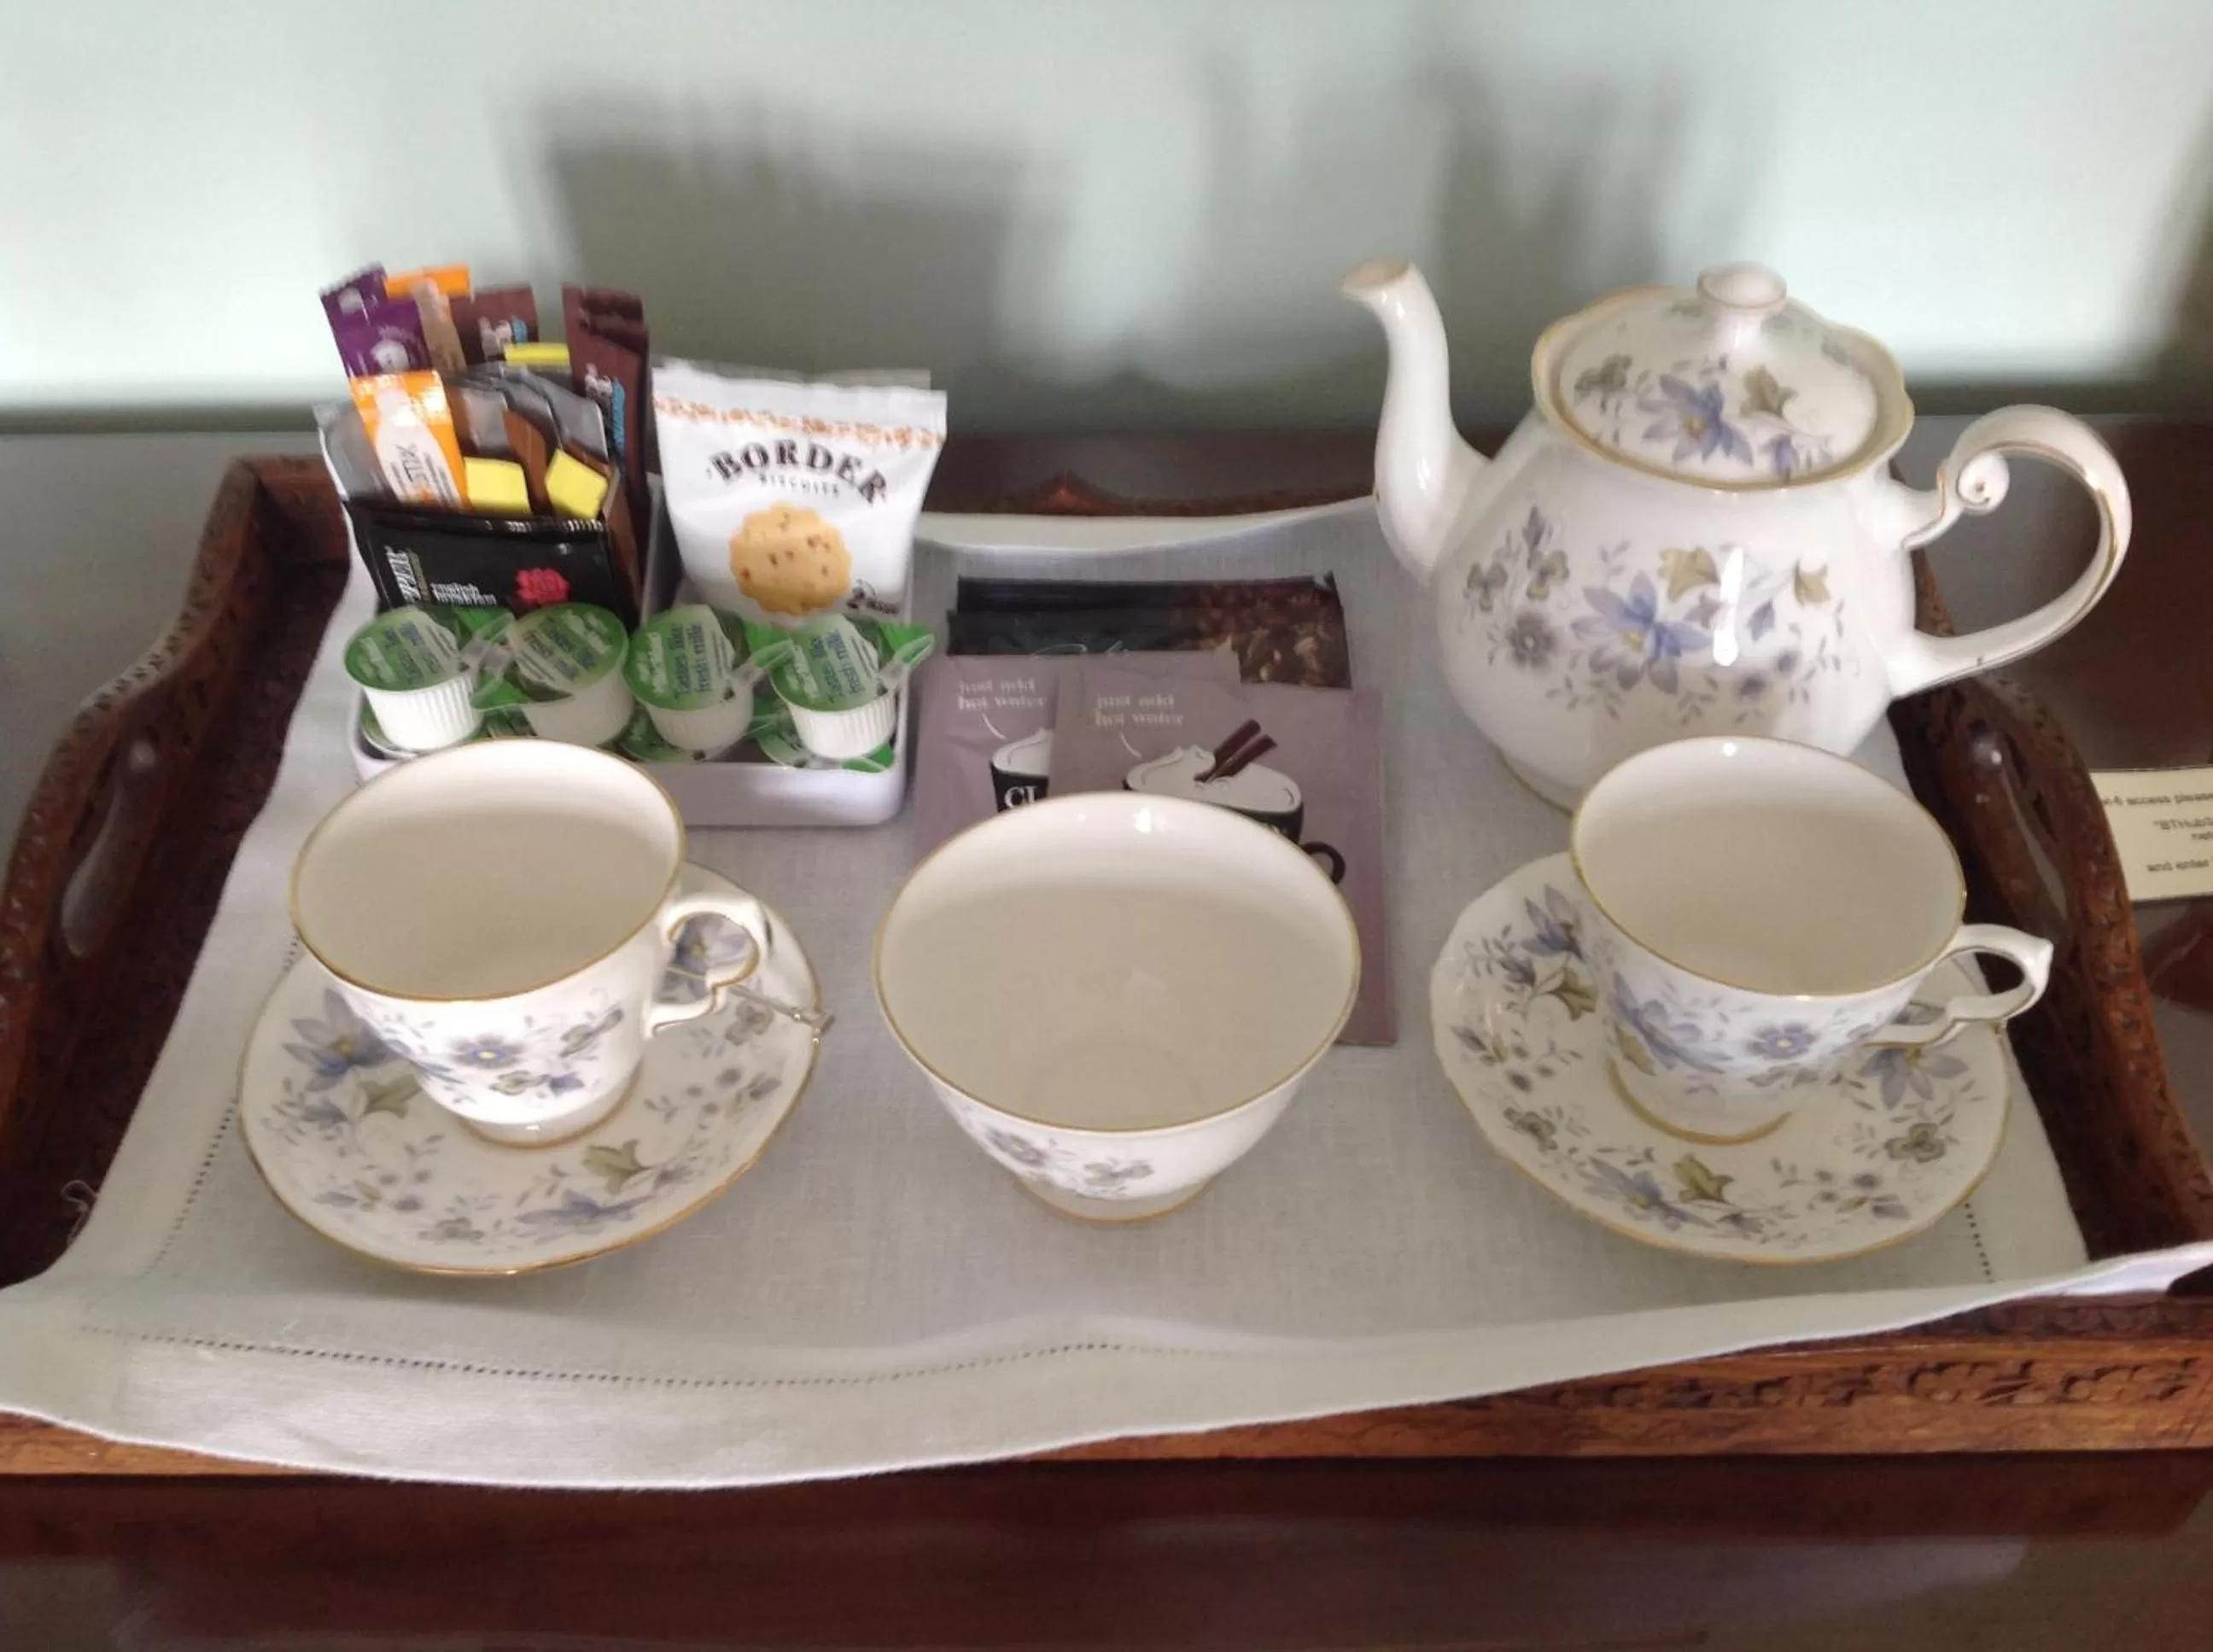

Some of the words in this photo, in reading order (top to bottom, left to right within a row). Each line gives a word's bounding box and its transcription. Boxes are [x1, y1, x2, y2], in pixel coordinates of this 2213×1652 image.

[709, 439, 887, 504] BORDER
[957, 696, 987, 712] hot
[1095, 710, 1124, 729] hot
